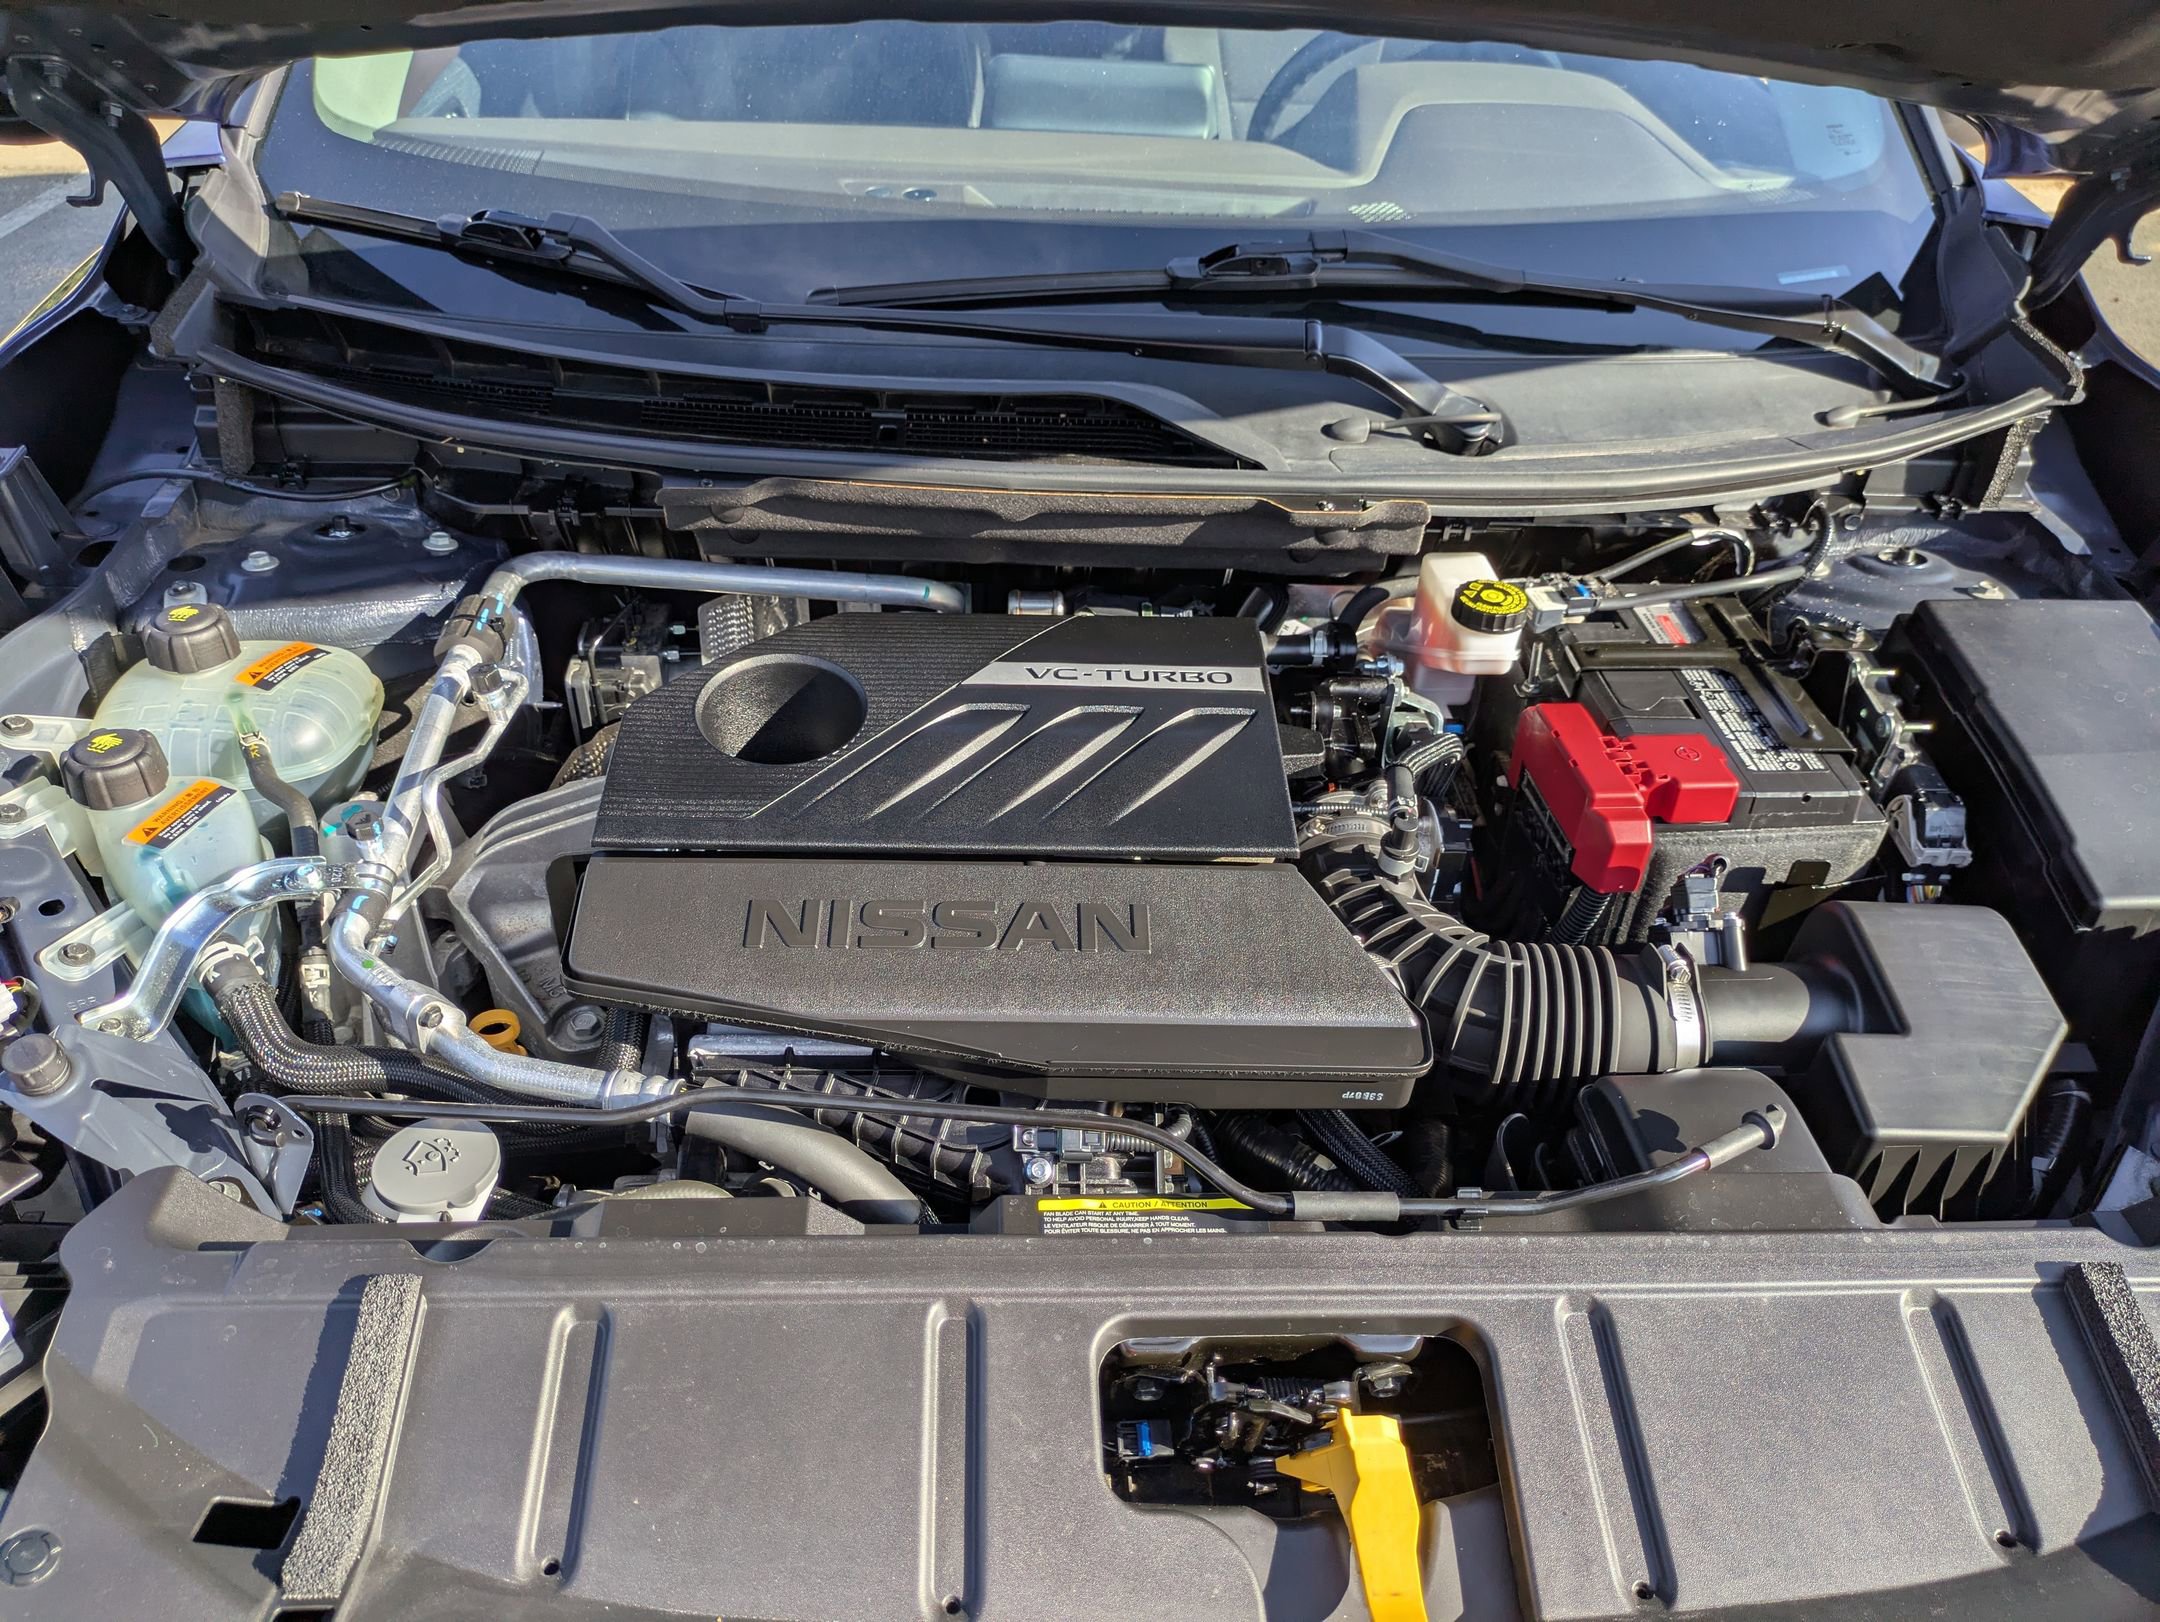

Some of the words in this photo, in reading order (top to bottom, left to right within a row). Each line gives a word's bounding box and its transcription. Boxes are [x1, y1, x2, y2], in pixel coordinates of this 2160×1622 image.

[1024, 666, 1233, 685] VC-TURBO
[742, 899, 1152, 954] NISSAN
[1112, 1201, 1151, 1209] CAUTION
[1161, 1200, 1208, 1208] ATTENTION
